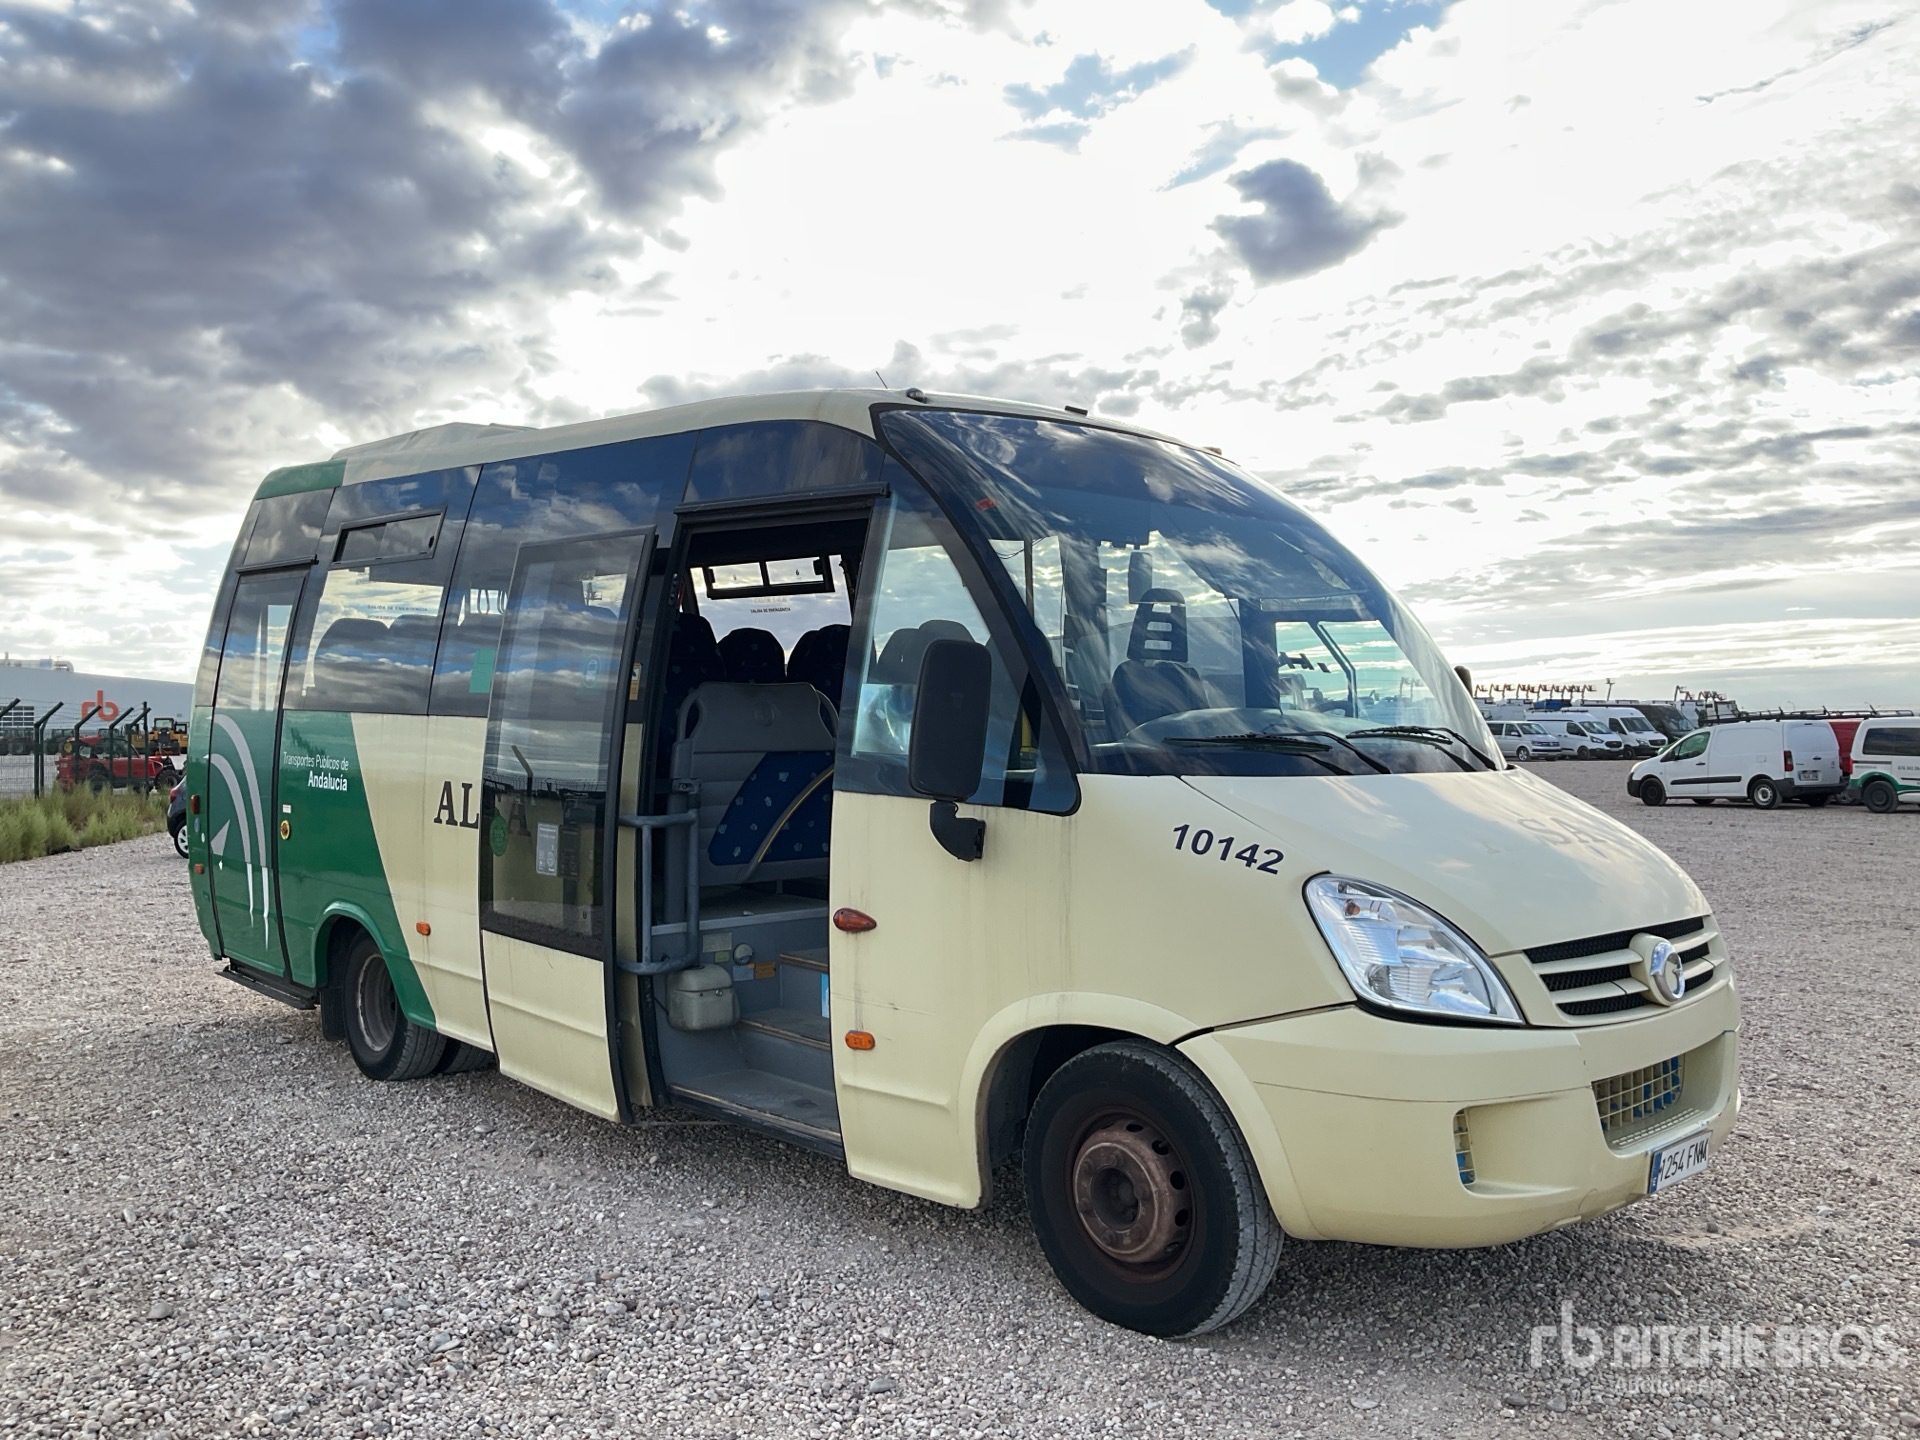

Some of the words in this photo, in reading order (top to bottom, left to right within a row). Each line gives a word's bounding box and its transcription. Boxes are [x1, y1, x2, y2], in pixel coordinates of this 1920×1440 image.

[283, 751, 315, 768] Transportes
[315, 754, 340, 770] Públicos
[340, 757, 349, 771] de
[307, 770, 348, 791] Andalucía
[1172, 823, 1285, 875] 10142
[1658, 1148, 1686, 1182] 1254
